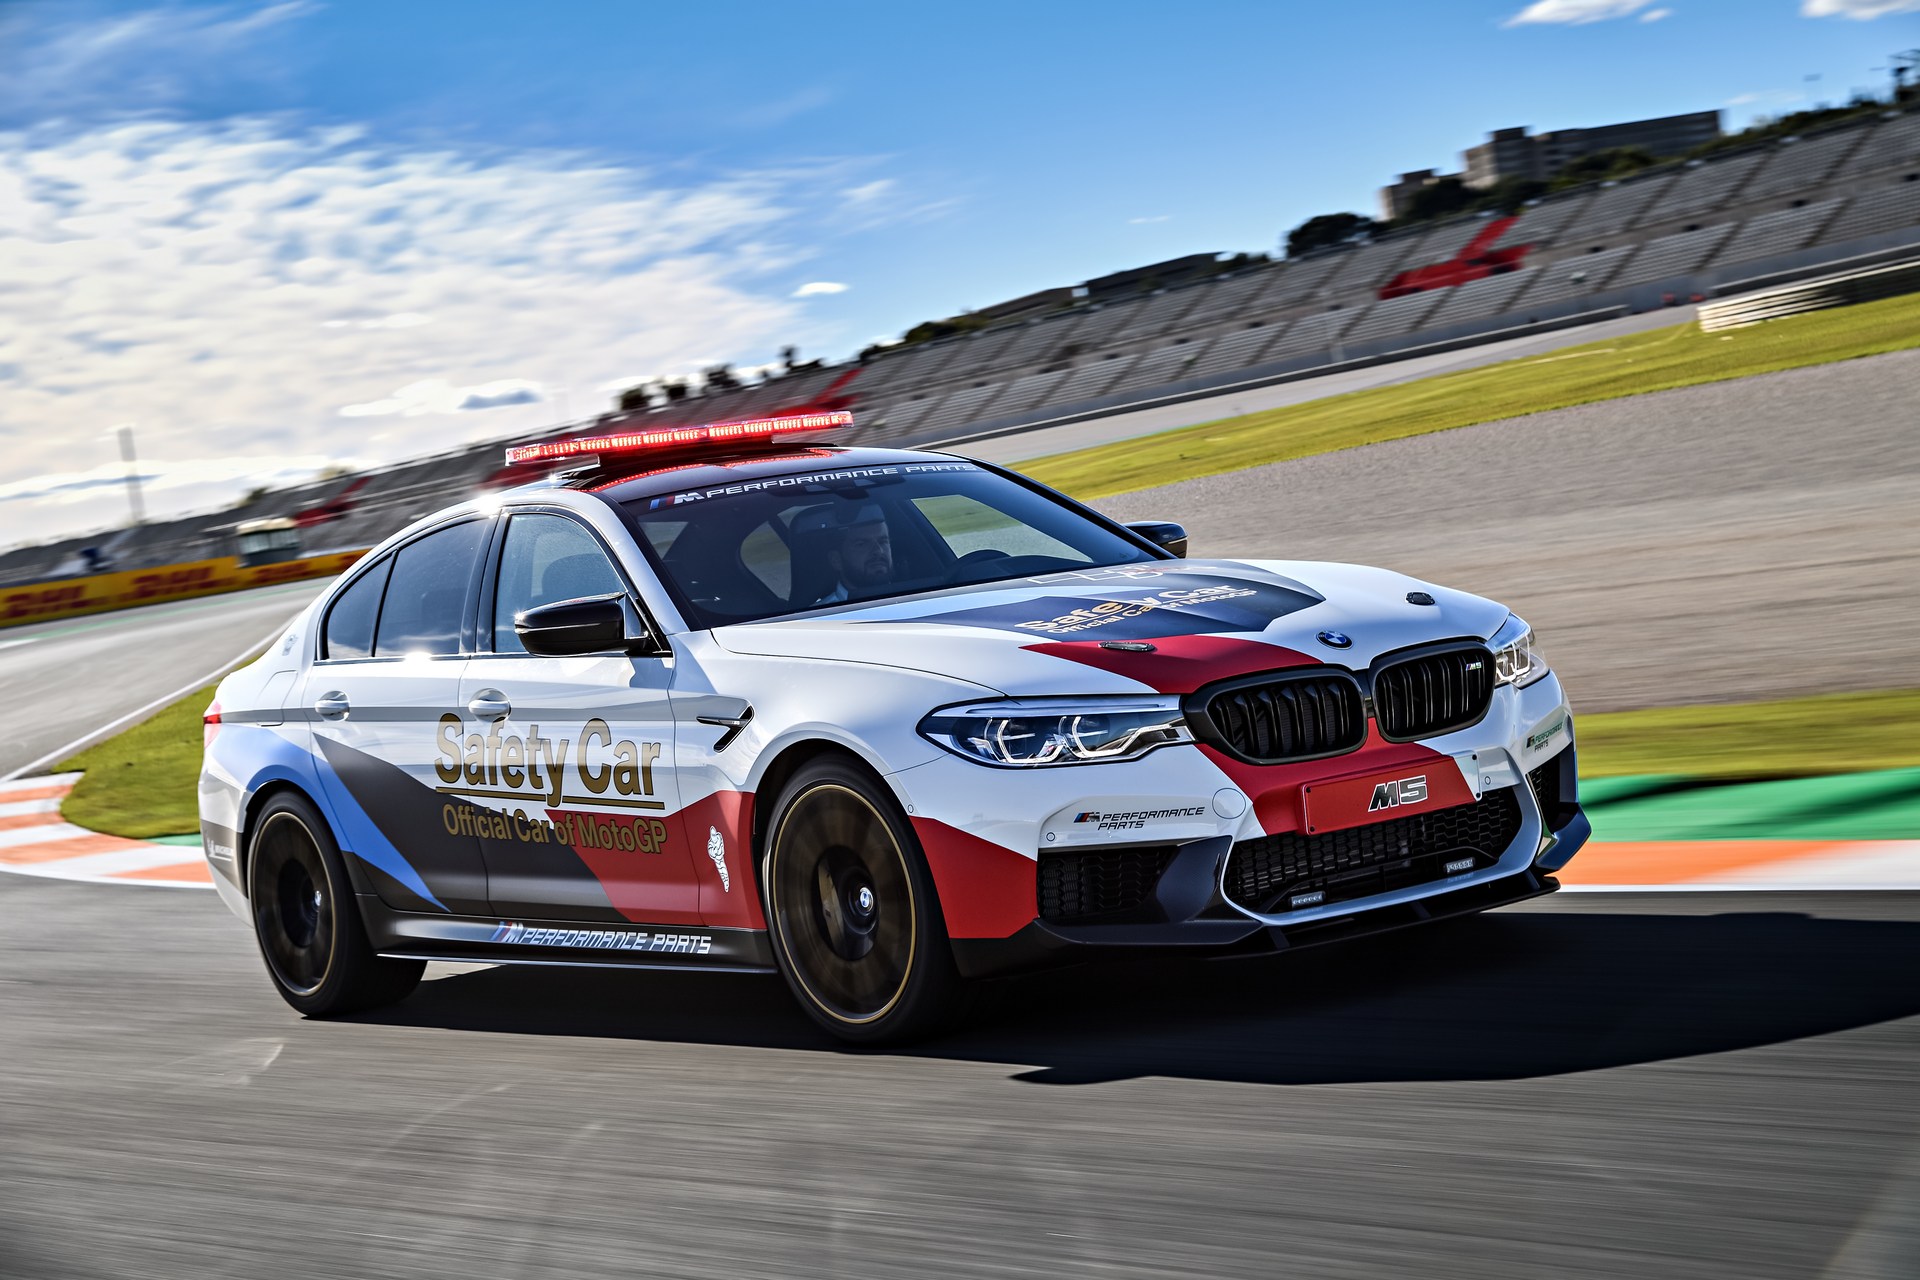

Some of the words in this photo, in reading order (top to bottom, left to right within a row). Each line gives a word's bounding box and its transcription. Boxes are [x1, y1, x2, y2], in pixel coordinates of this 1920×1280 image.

[434, 712, 570, 807] Safety
[577, 717, 661, 796] Car
[1368, 775, 1428, 812] M5
[443, 803, 513, 840] Official
[513, 808, 551, 844] Car
[554, 813, 577, 846] of
[574, 813, 668, 854] MotoGP
[1098, 820, 1145, 831] PARTS
[1101, 807, 1205, 822] PERFORMANCE
[649, 933, 712, 954] PARTS
